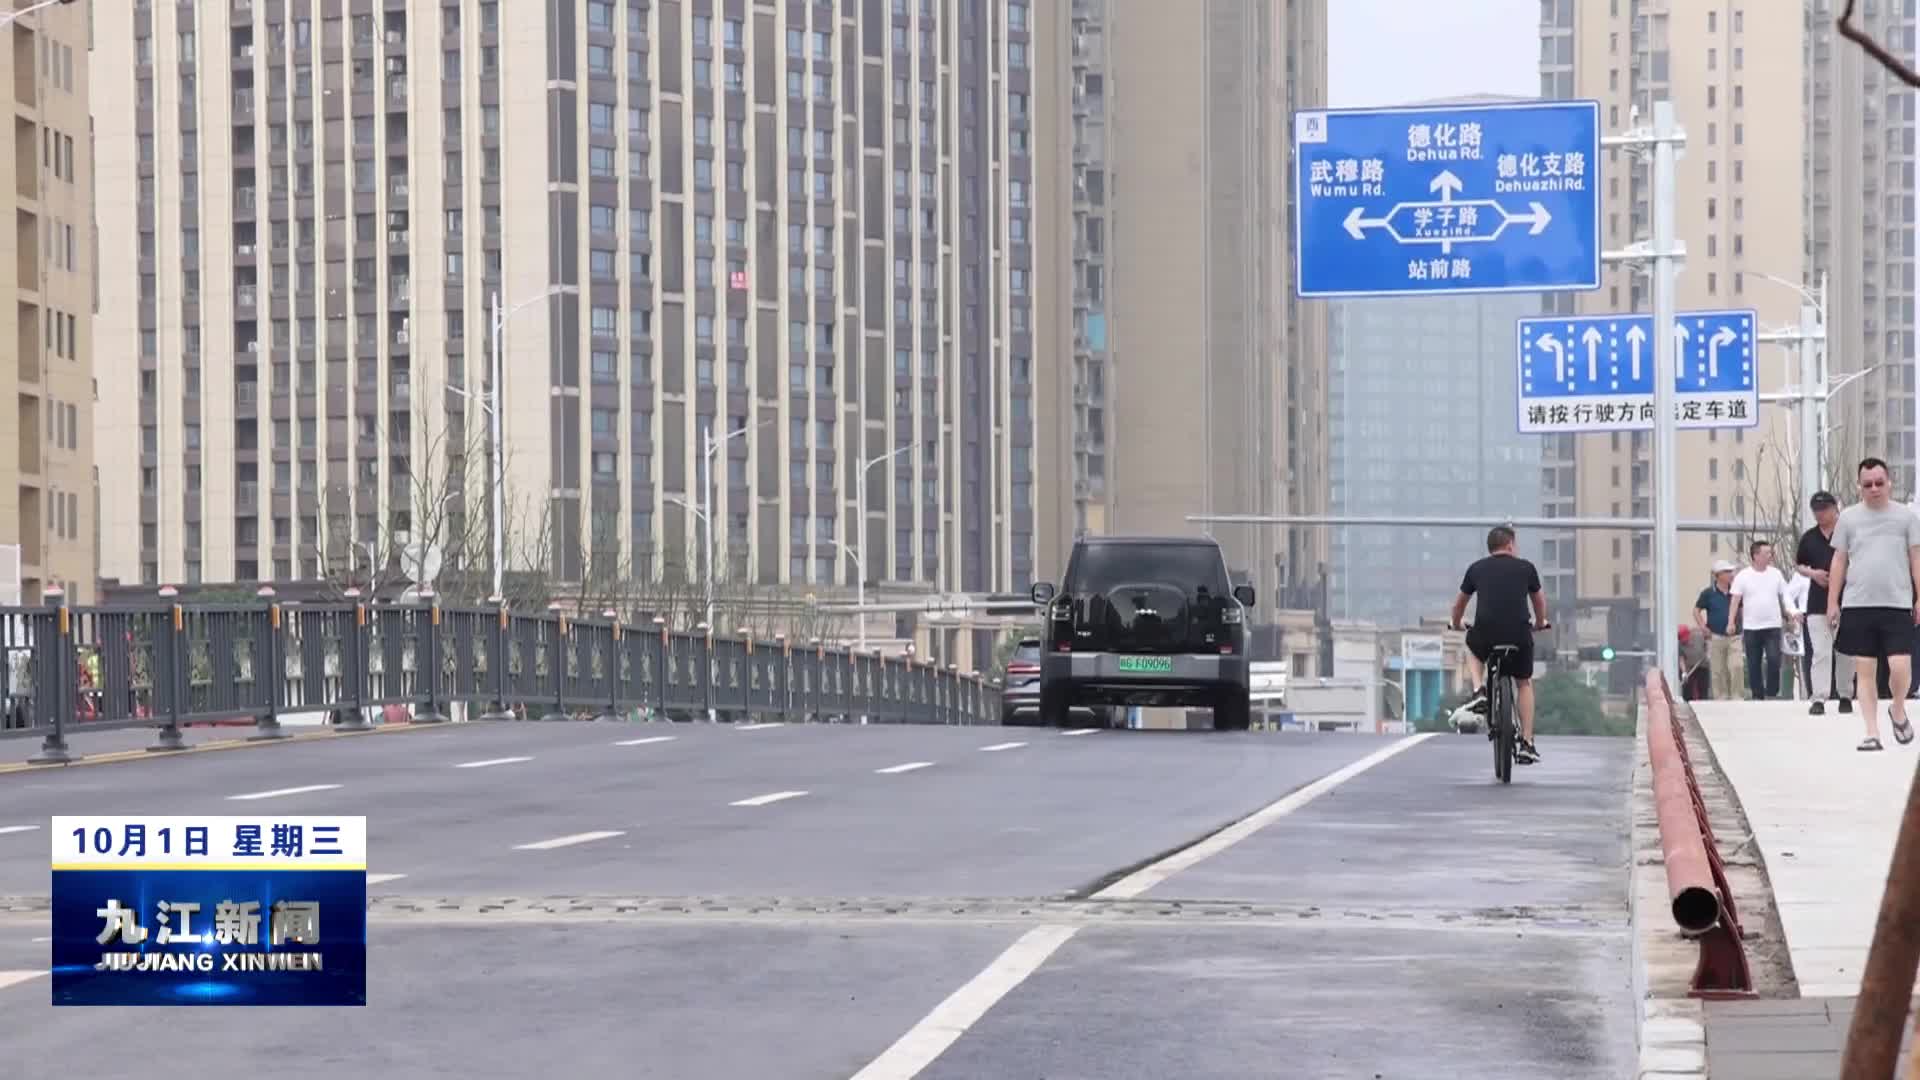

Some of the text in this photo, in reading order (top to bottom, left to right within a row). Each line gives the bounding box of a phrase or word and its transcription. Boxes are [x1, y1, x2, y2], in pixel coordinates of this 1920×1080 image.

[1407, 123, 1483, 148] 德化路
[1407, 146, 1484, 161] Dehua Rd.
[1309, 158, 1385, 183] 武穆路
[1496, 152, 1585, 178] 德化支路
[1311, 183, 1386, 197] Wumu Rd.
[1495, 177, 1585, 193] Dehuazhi Rd.
[1413, 206, 1478, 227] 学子路
[1407, 258, 1472, 280] 站前路
[1527, 399, 1747, 425] 请按行驶方向定车道
